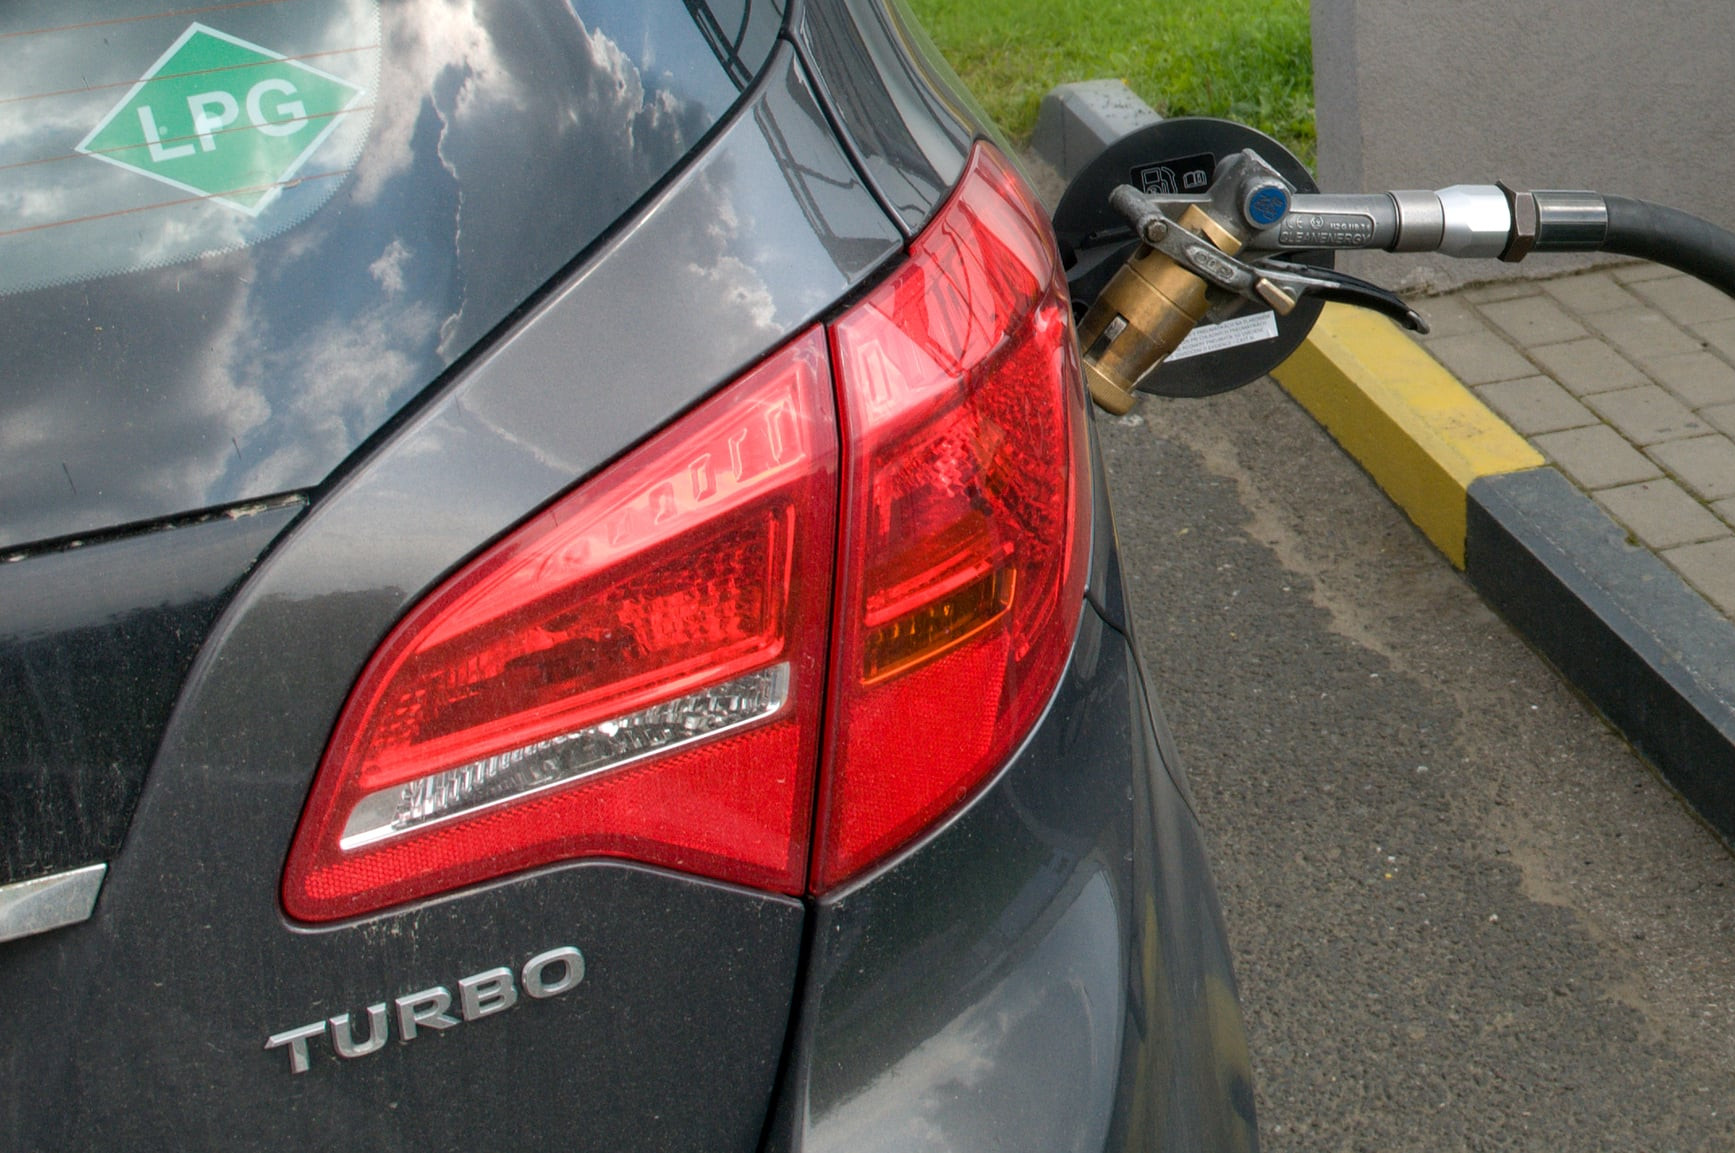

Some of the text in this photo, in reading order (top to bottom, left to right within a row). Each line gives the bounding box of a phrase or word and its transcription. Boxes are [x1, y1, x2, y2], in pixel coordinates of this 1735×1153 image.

[135, 78, 310, 163] LPG
[1280, 230, 1370, 245] CLEANENERGY
[264, 946, 585, 1073] TURBO
